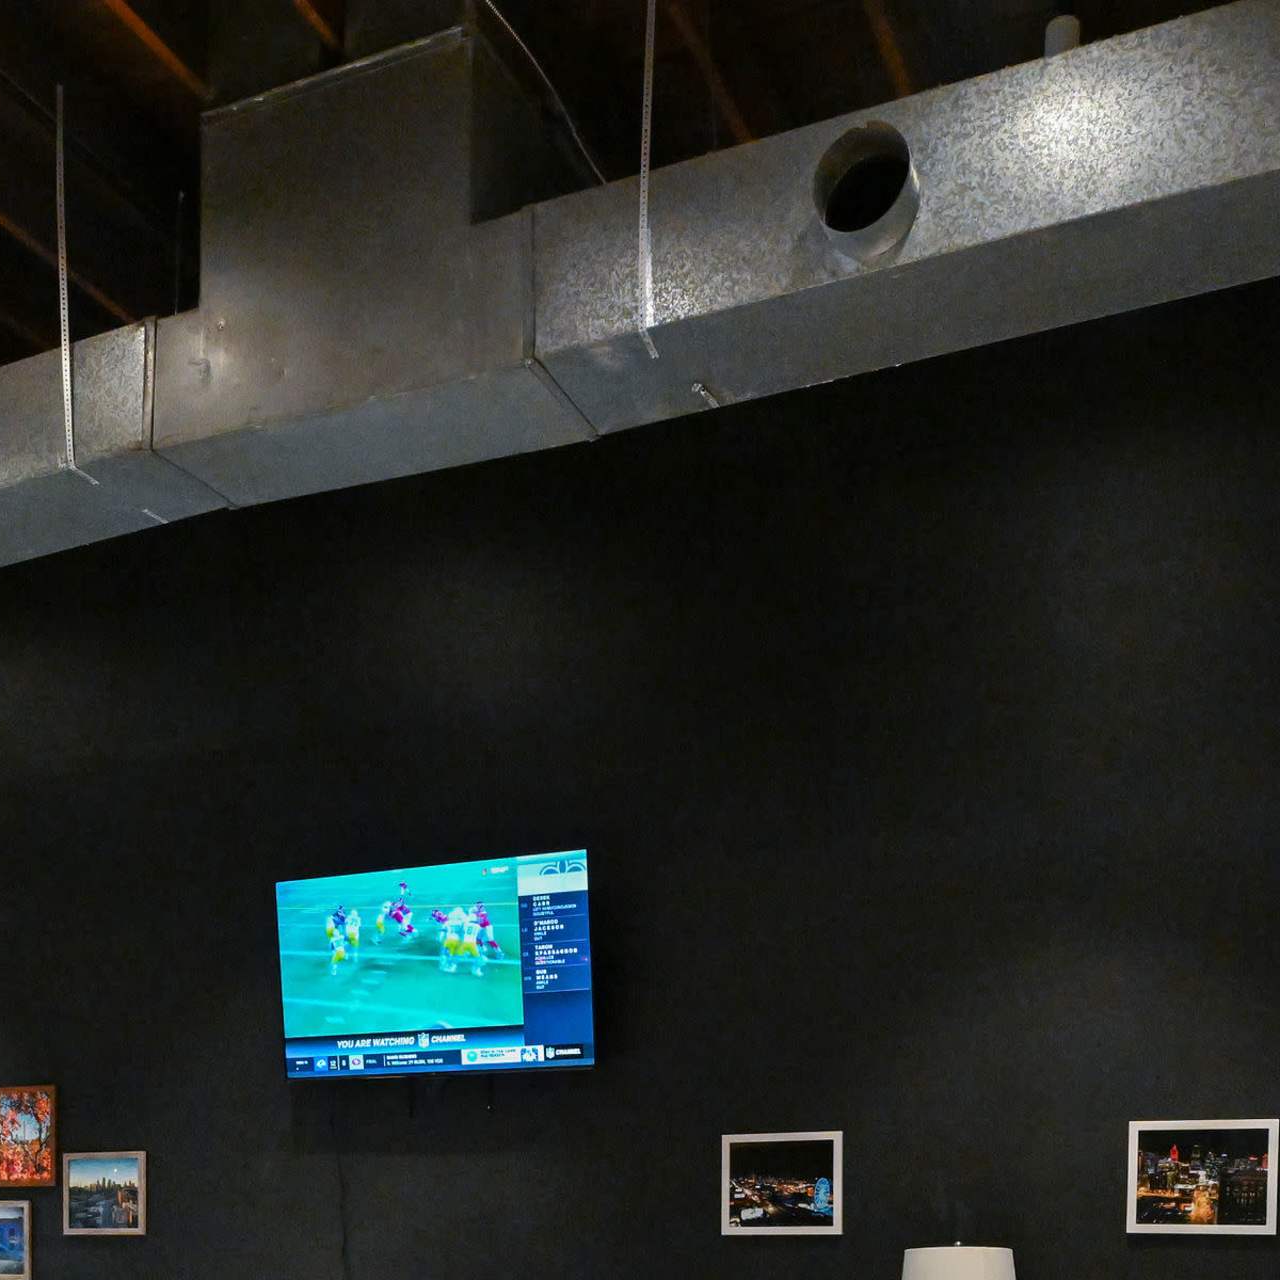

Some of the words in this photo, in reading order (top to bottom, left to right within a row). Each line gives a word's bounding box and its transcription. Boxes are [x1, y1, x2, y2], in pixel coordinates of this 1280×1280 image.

[337, 1040, 353, 1049] YOU
[354, 1039, 371, 1048] ARE
[372, 1036, 415, 1047] WATCHING
[431, 1034, 466, 1043] CHANNEL
